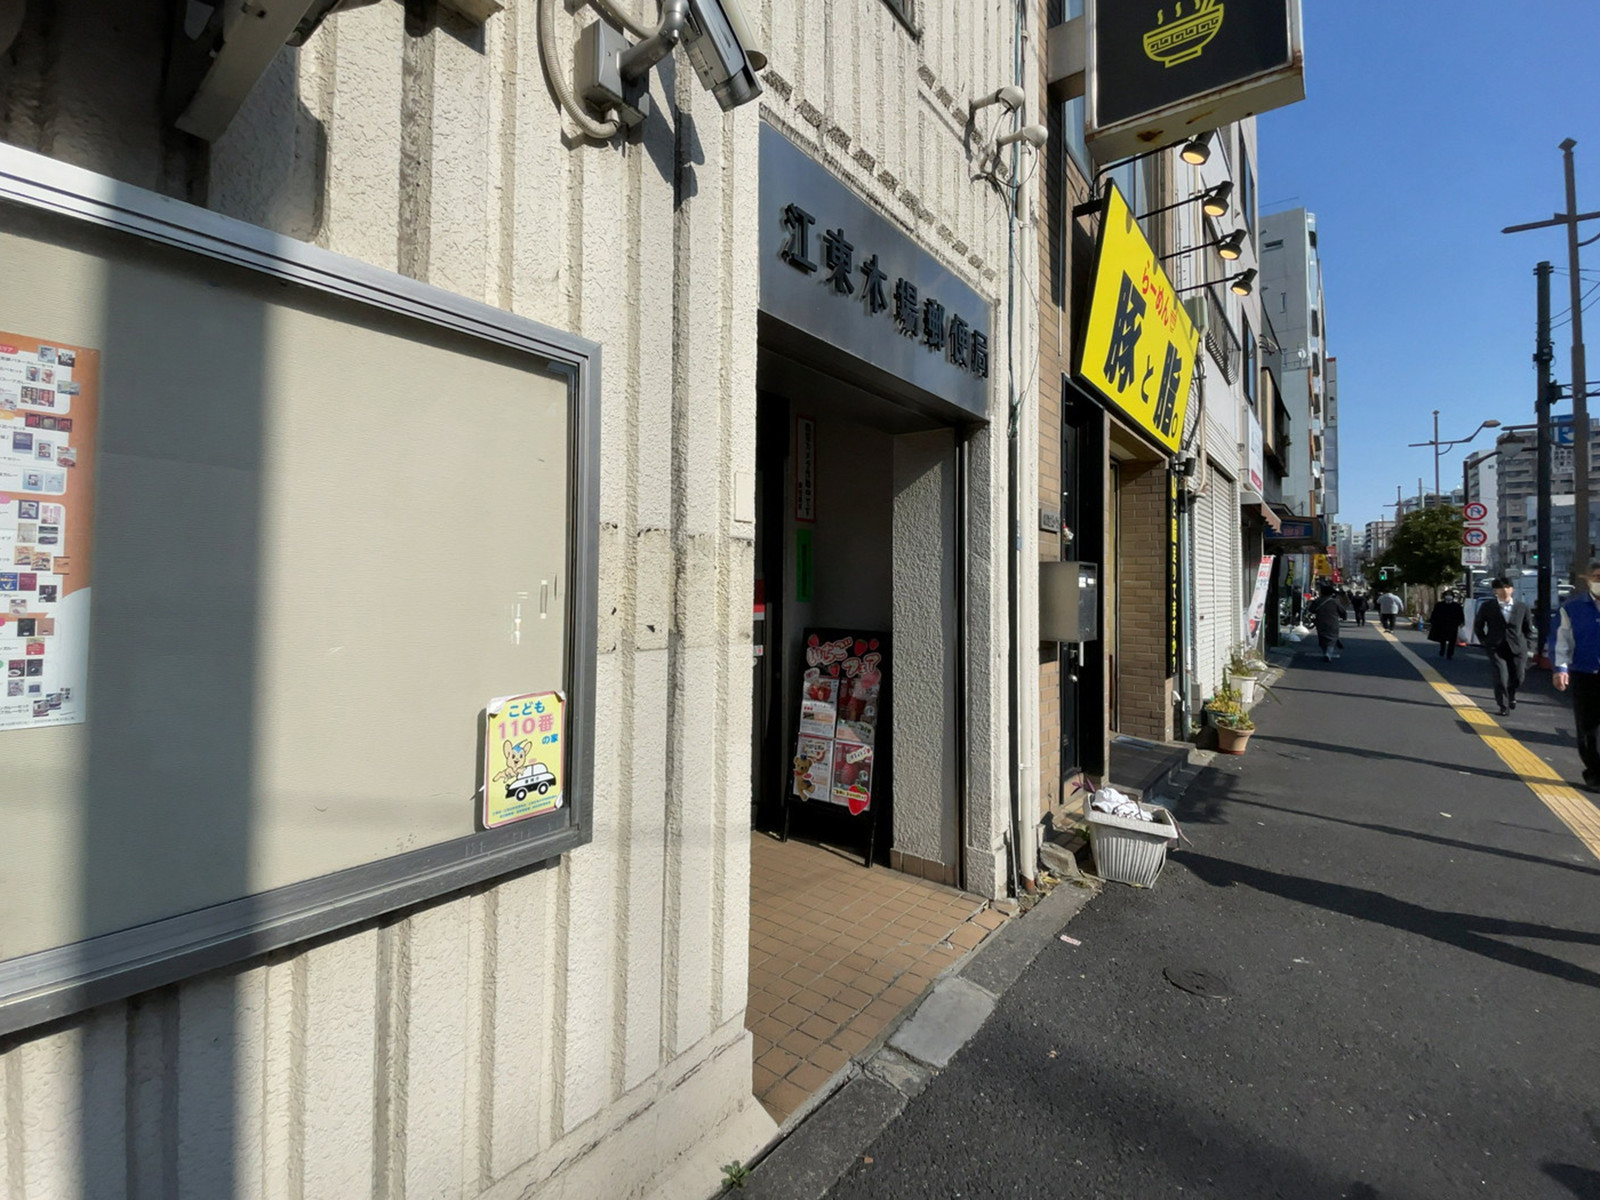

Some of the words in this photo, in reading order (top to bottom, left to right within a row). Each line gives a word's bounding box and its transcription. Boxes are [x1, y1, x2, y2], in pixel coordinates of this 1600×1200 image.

[780, 203, 988, 378] 江東木場郵便局
[509, 701, 545, 717] こども
[498, 714, 553, 739] 110番
[541, 733, 559, 745] の家
